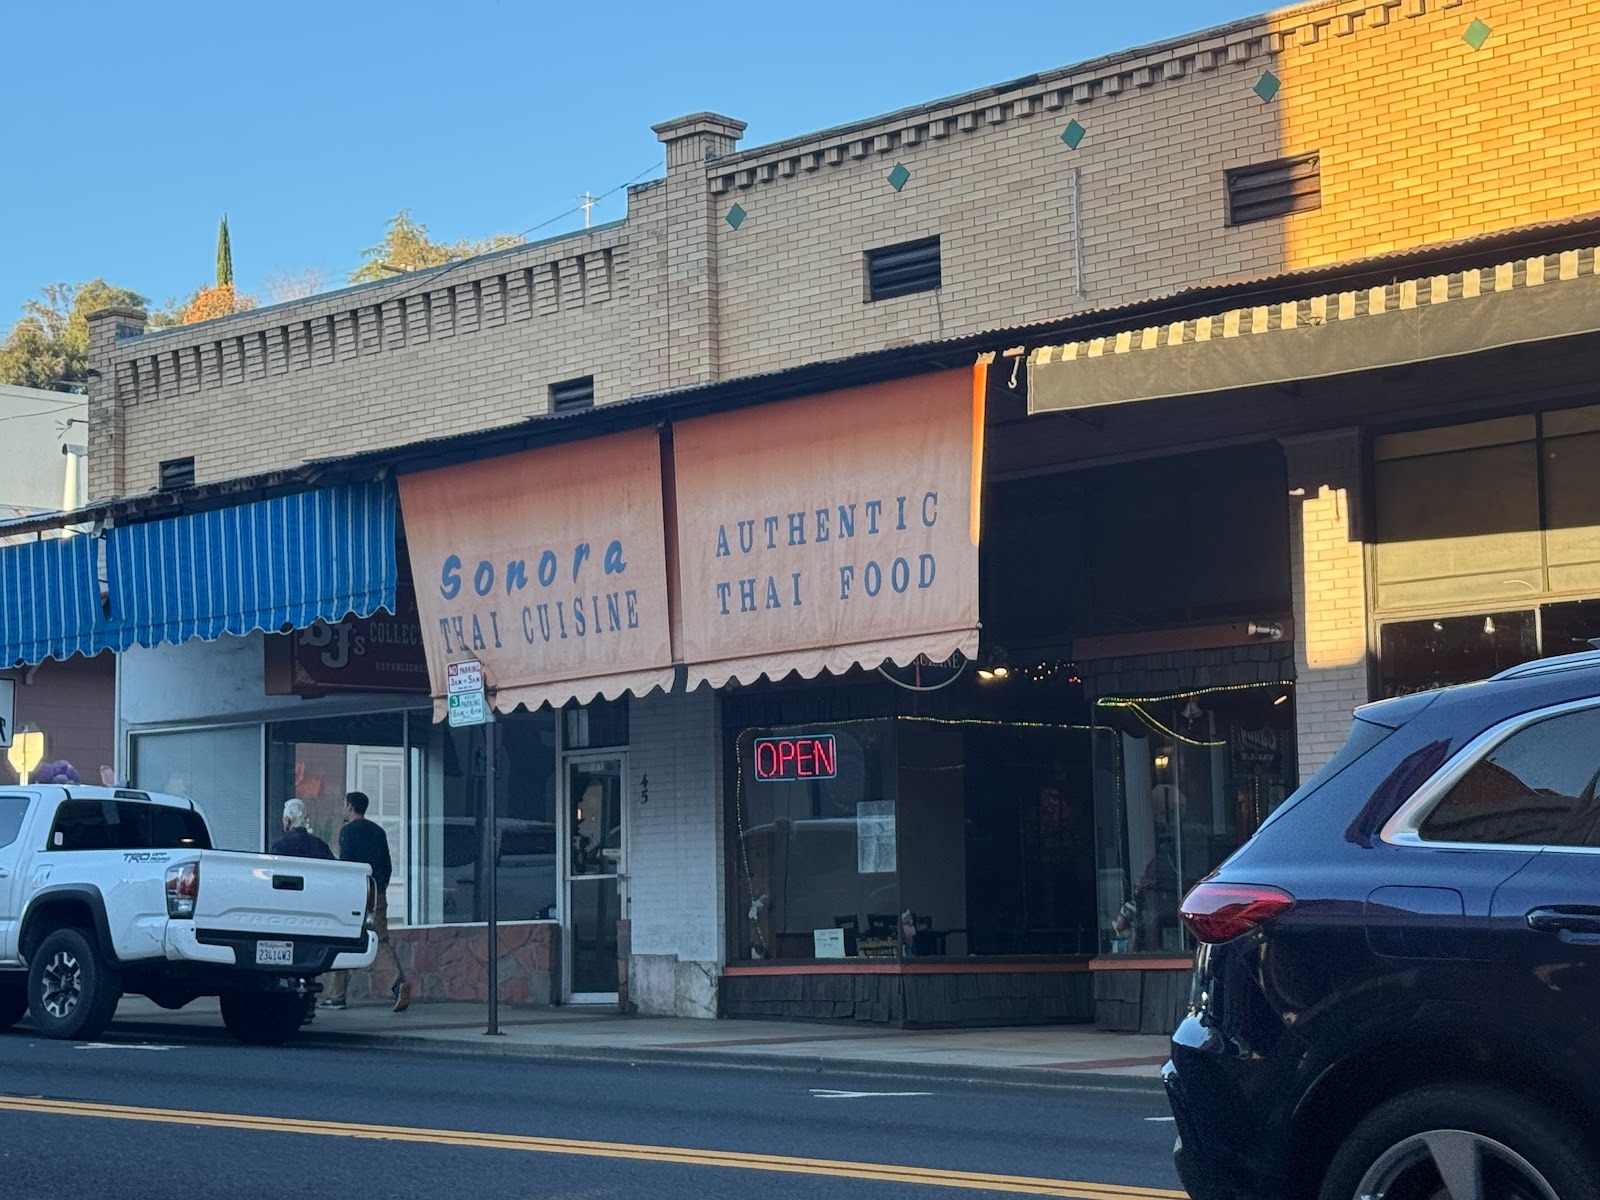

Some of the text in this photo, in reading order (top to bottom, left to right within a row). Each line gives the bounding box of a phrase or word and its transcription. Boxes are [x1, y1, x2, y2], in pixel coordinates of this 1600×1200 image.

[715, 492, 938, 558] AUTHENTIC
[439, 539, 628, 602] Sonora
[716, 553, 936, 616] THAI FOOD
[438, 588, 640, 656] THAI CUISINE
[460, 664, 480, 674] PARKING
[757, 738, 834, 778] OPEN
[123, 852, 150, 863] TRD
